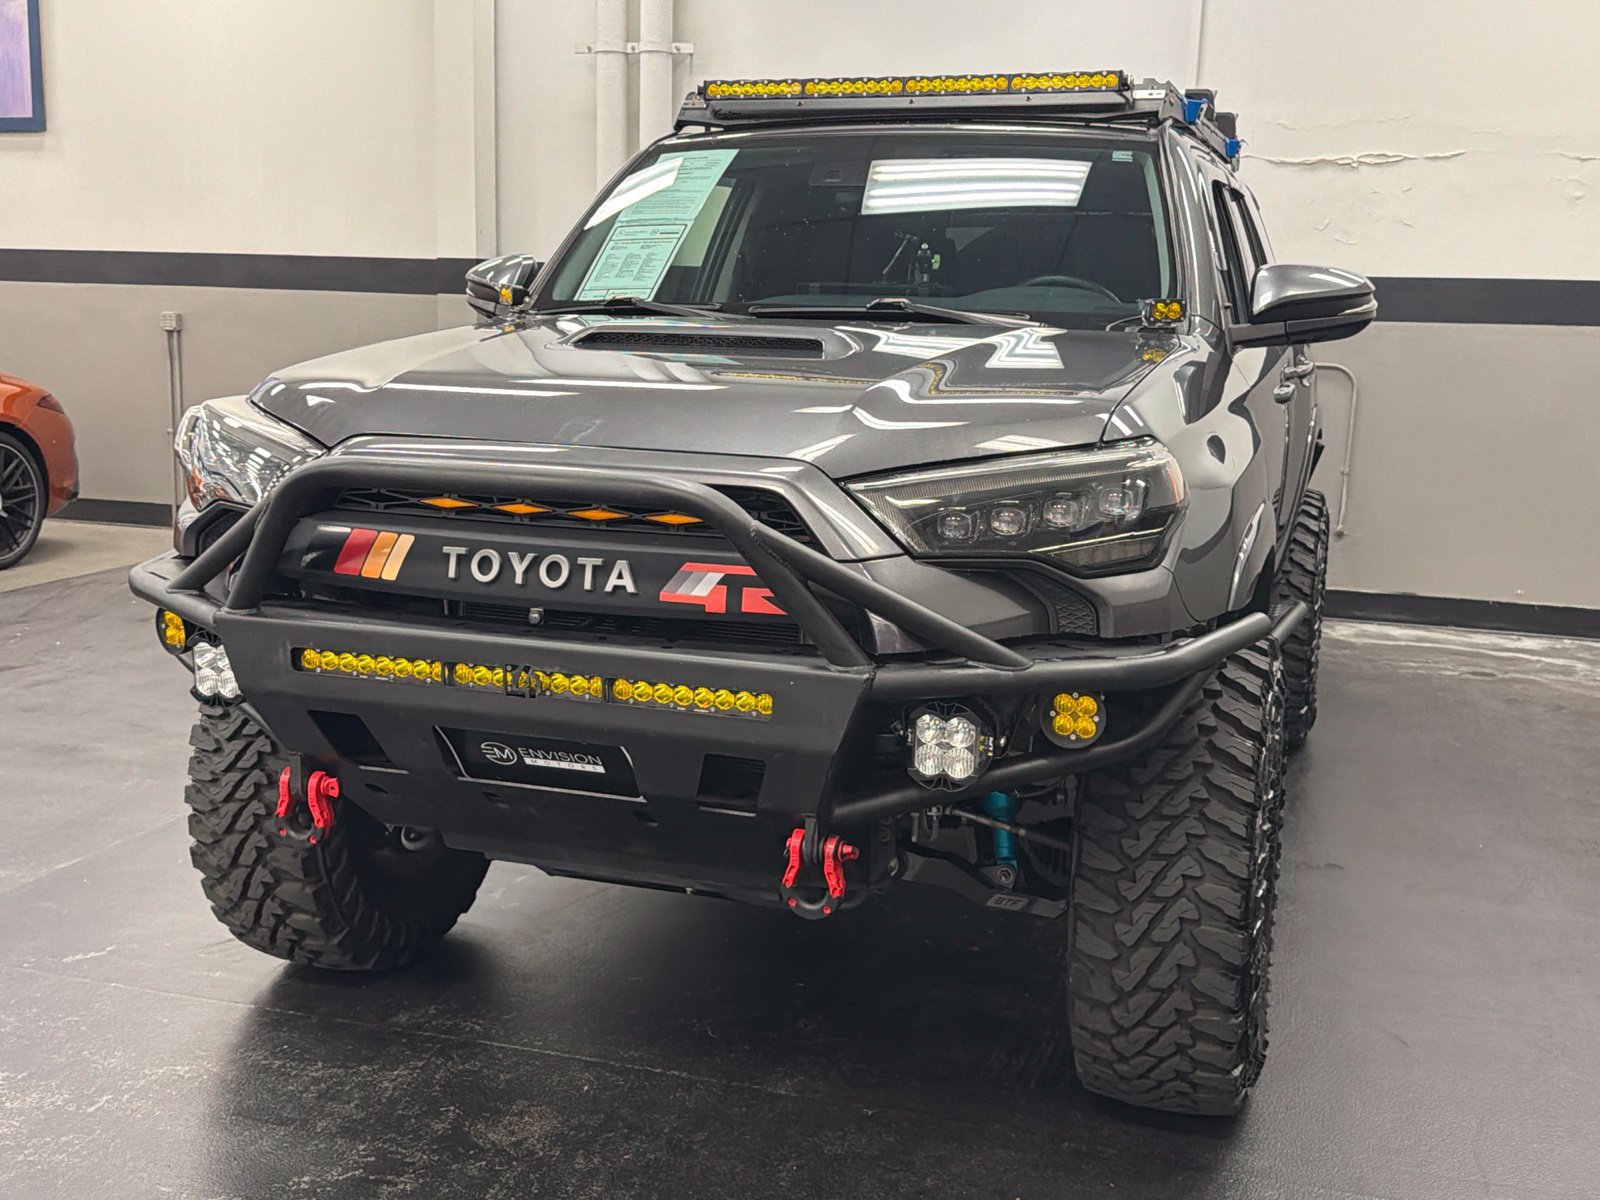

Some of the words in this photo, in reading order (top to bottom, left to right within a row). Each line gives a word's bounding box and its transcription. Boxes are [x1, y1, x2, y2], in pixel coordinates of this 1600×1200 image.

[442, 546, 639, 594] TOYOTA
[518, 747, 602, 765] ENVISION
[530, 759, 598, 771] MOTORS
